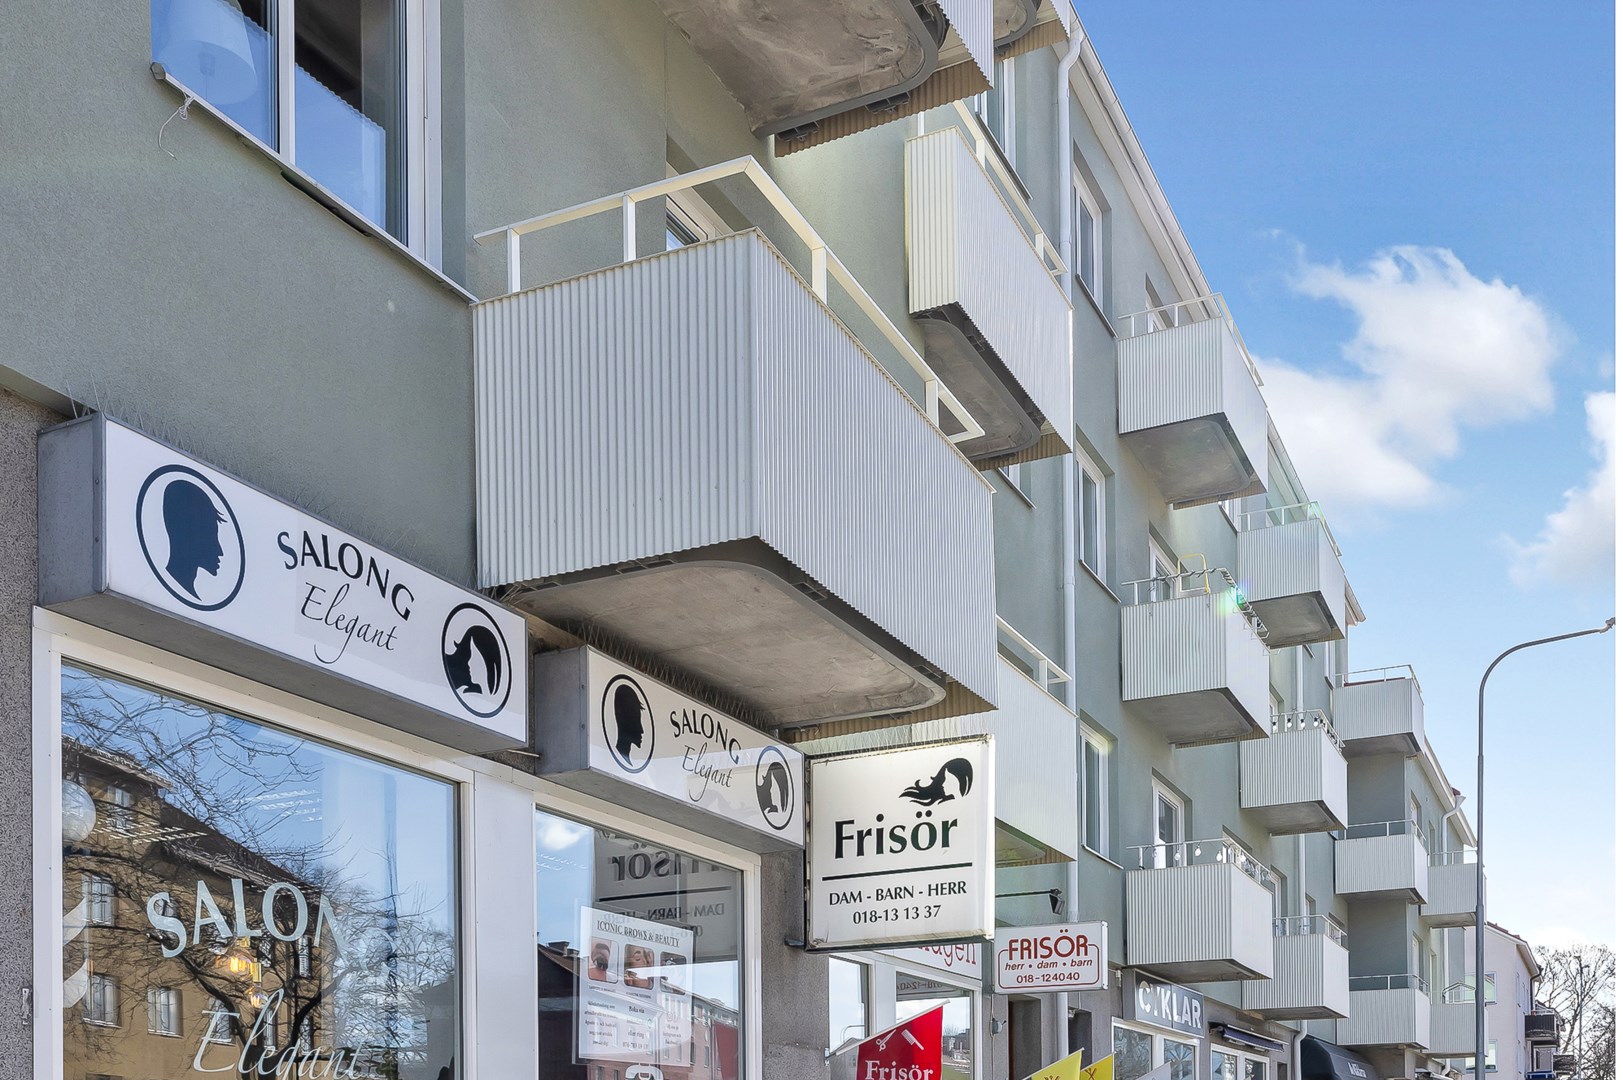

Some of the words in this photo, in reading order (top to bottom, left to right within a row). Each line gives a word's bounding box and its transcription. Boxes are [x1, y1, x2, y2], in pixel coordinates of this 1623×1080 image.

[277, 530, 415, 622] SALONG
[300, 582, 398, 665] Elegant
[670, 708, 742, 765] SALONG
[682, 742, 733, 802] Elegant
[835, 810, 958, 859] Frisör
[829, 890, 863, 906] DAM
[875, 885, 914, 902] BARN
[928, 880, 967, 897] HERR
[597, 920, 624, 935] ICONIC
[624, 926, 648, 941] BROWS
[648, 932, 654, 941] &
[655, 933, 680, 948] BEAUTY
[853, 908, 899, 924] 018-13
[904, 906, 920, 920] 13
[924, 904, 942, 918] 37
[1004, 962, 1025, 971] herr
[1037, 960, 1058, 969] dam
[1070, 958, 1093, 967] barn
[1008, 928, 1088, 961] FRISÖR
[1016, 971, 1080, 984] 018-124040
[1138, 980, 1202, 1029] CYKLAR
